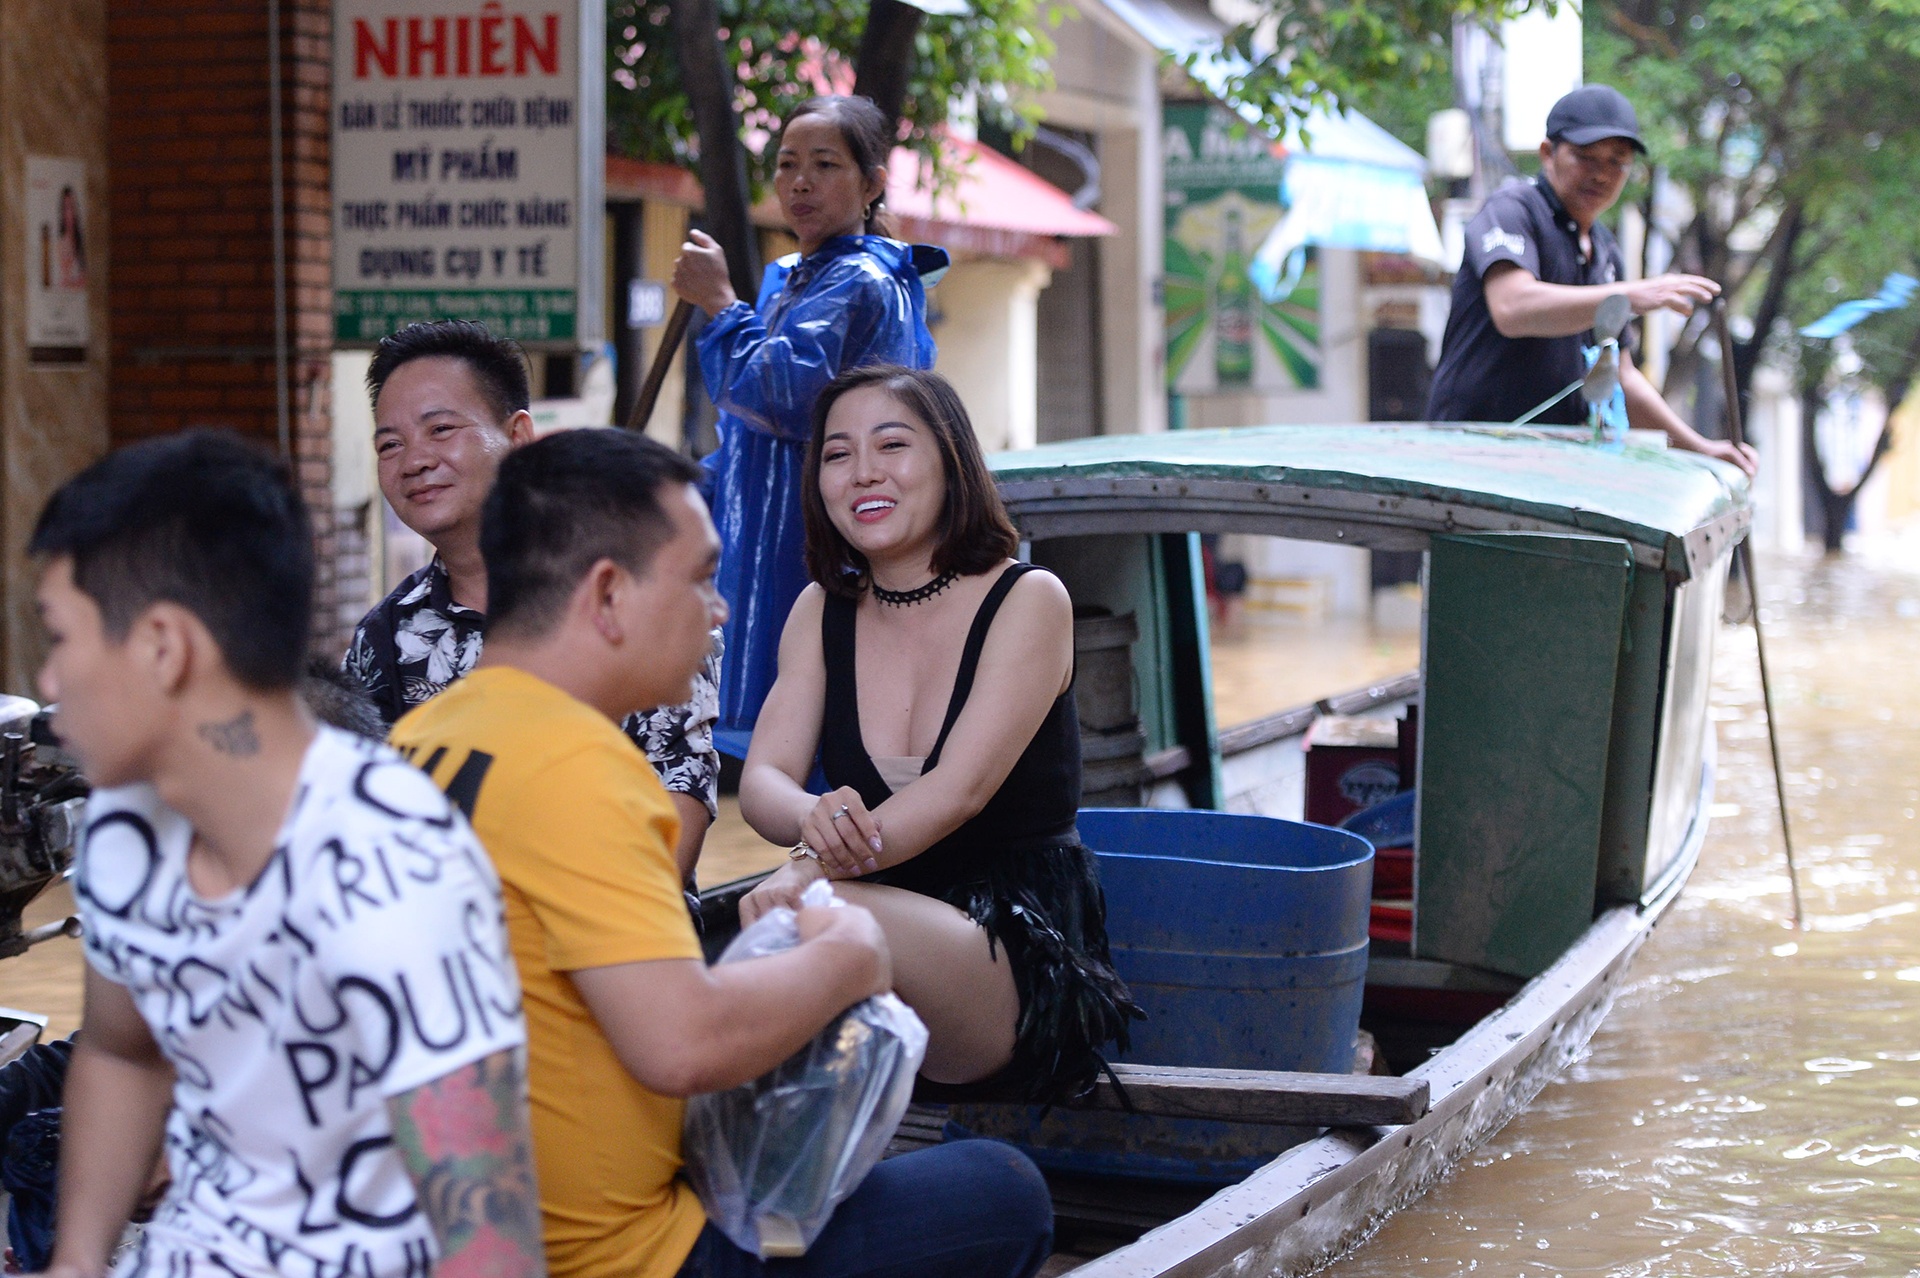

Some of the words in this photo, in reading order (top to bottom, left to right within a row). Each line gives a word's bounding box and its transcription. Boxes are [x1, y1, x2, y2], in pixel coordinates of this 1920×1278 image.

[355, 2, 560, 78] NHIÊN
[524, 94, 571, 134] BỆNH
[440, 134, 518, 180] PHẨM
[396, 192, 451, 228] PHẨM
[459, 195, 508, 228] CHỨC
[516, 195, 569, 228] NĂNG
[359, 246, 435, 280] DỤNG
[444, 246, 483, 281] CỤ
[492, 246, 509, 277] Y
[517, 237, 548, 278] TẾ
